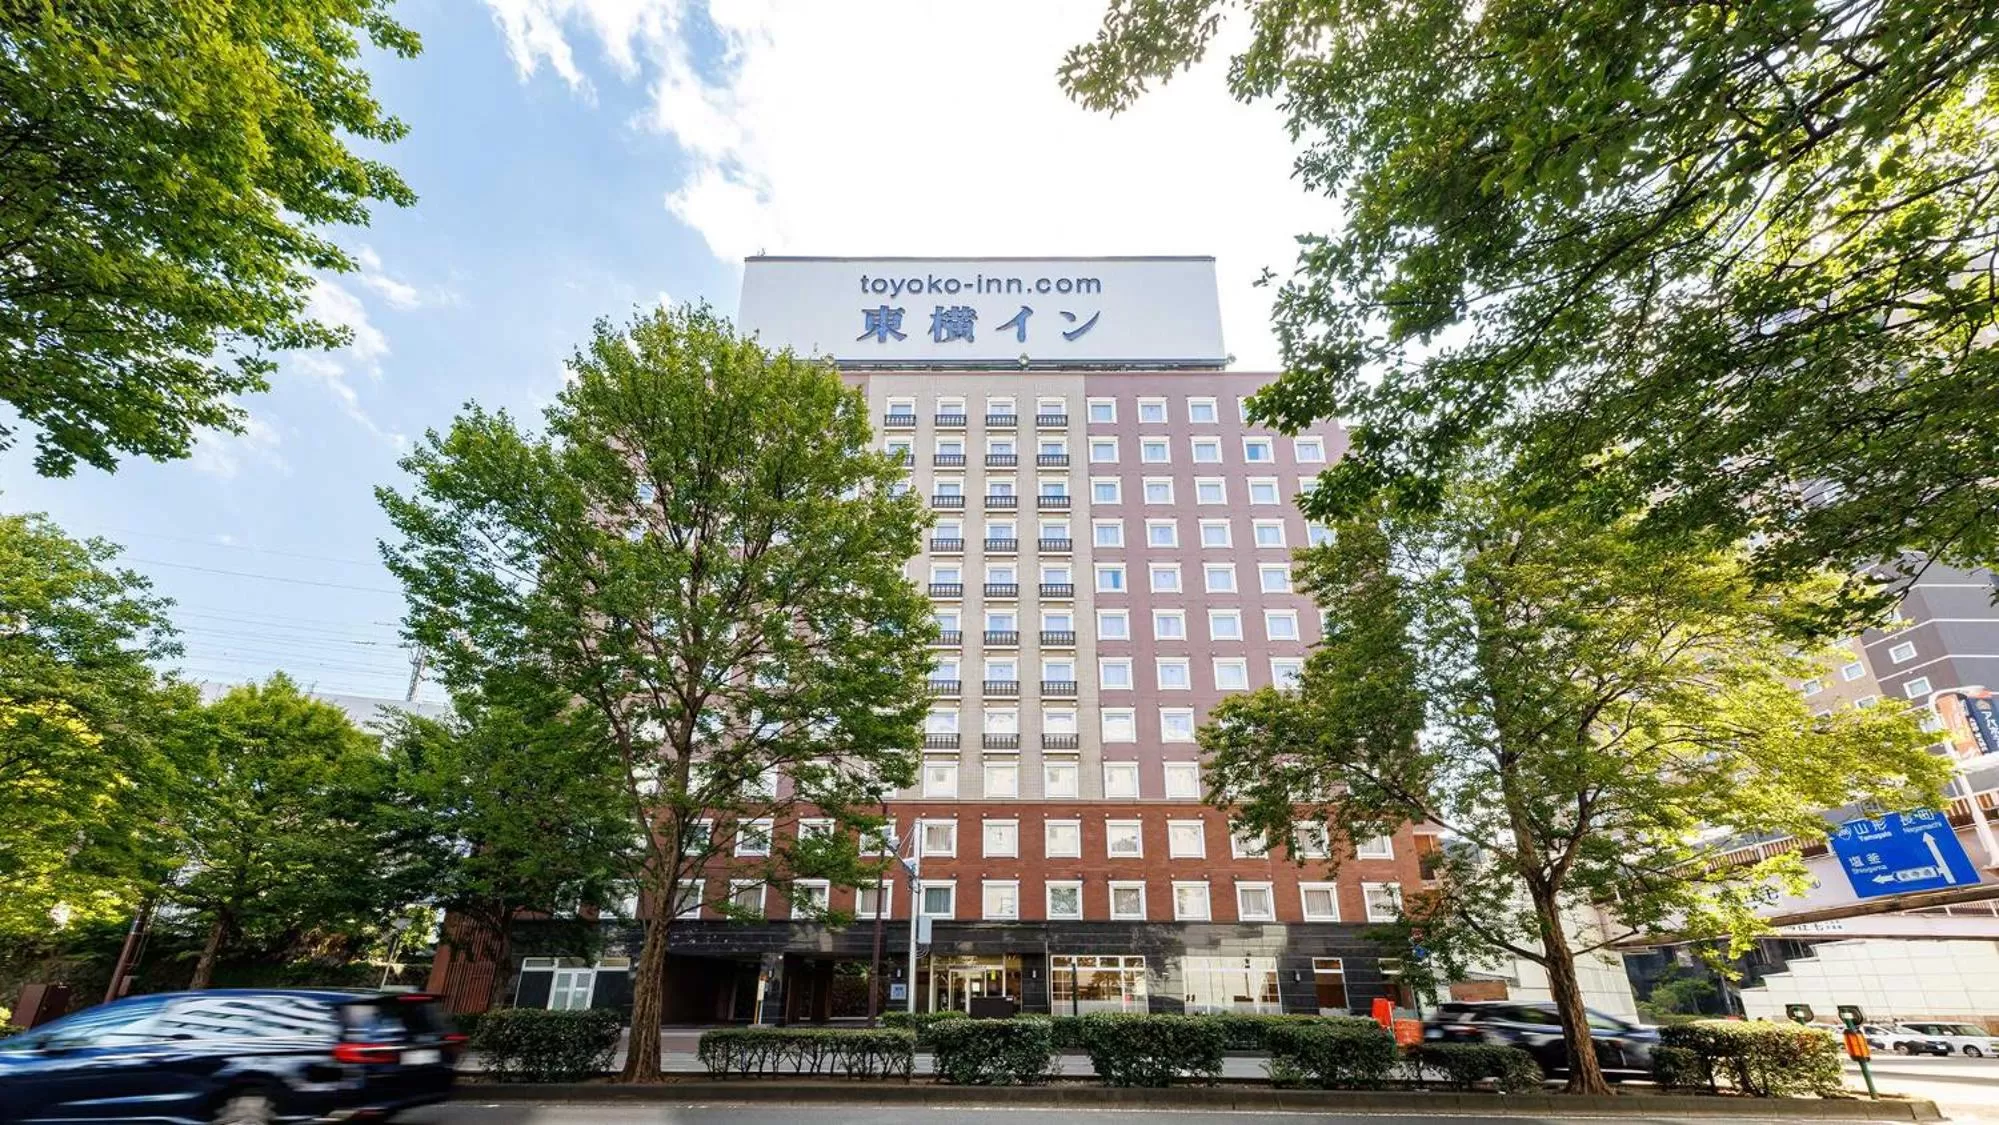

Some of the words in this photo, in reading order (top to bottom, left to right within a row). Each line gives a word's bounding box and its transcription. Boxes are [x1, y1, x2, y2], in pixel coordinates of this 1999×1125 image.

[860, 274, 1101, 299] toyoko-inn.com
[856, 304, 1101, 343] 東横イン
[1853, 817, 1887, 835] 山形
